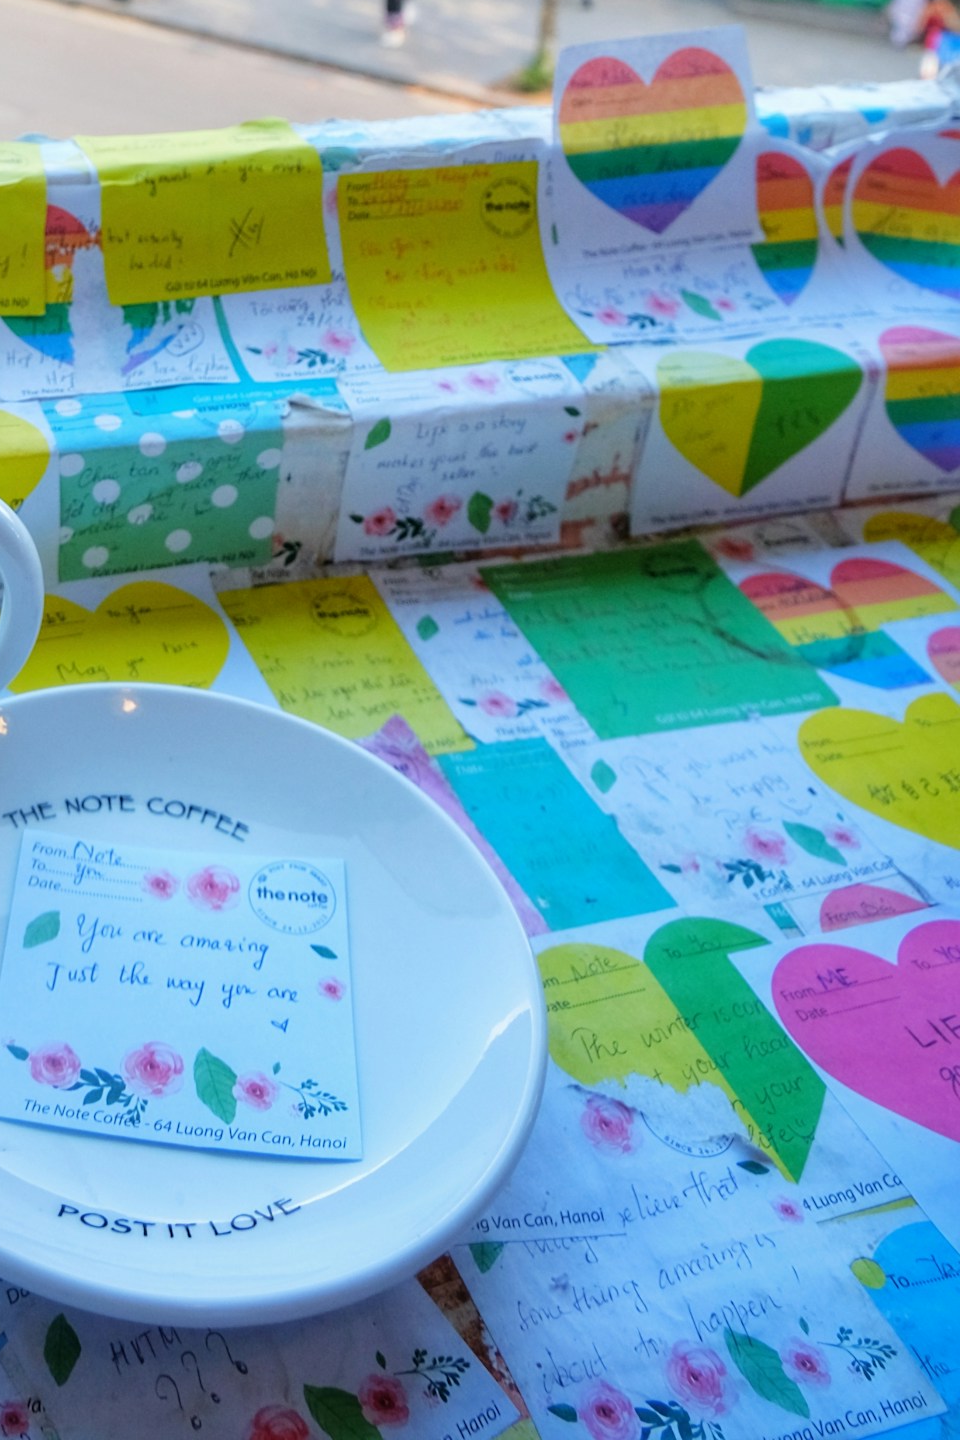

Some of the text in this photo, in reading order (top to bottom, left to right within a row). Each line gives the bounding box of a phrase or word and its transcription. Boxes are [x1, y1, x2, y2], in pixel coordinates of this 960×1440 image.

[2, 794, 250, 843] THE NOTE COFFEE
[32, 841, 68, 858] From
[73, 840, 123, 866] Note
[31, 858, 46, 871] To
[28, 875, 62, 891] Date
[257, 886, 328, 904] the note
[825, 910, 861, 925] From
[77, 913, 269, 970] You are amazing
[663, 948, 681, 960] To
[911, 960, 931, 971] To
[46, 961, 299, 1009] Just the way you are
[817, 968, 858, 991] ME
[780, 987, 816, 1002] From
[796, 1007, 828, 1022] Date
[571, 1027, 628, 1063] The
[640, 1012, 701, 1048] winter
[682, 1052, 729, 1086] your
[756, 1075, 804, 1114] your
[24, 1098, 348, 1150] The Note Coffee 64 Luong Van Can, Hanoi
[813, 1173, 903, 1210] Luong Van Ca
[57, 1197, 302, 1239] POST IT LOVE
[492, 1208, 605, 1229] Van Can, Hanoi
[659, 1243, 752, 1289] amazing
[756, 1233, 776, 1248] is
[886, 1273, 910, 1290] To
[456, 1401, 501, 1440] Hanoi
[812, 1391, 927, 1437] Van Can, Hanoi
